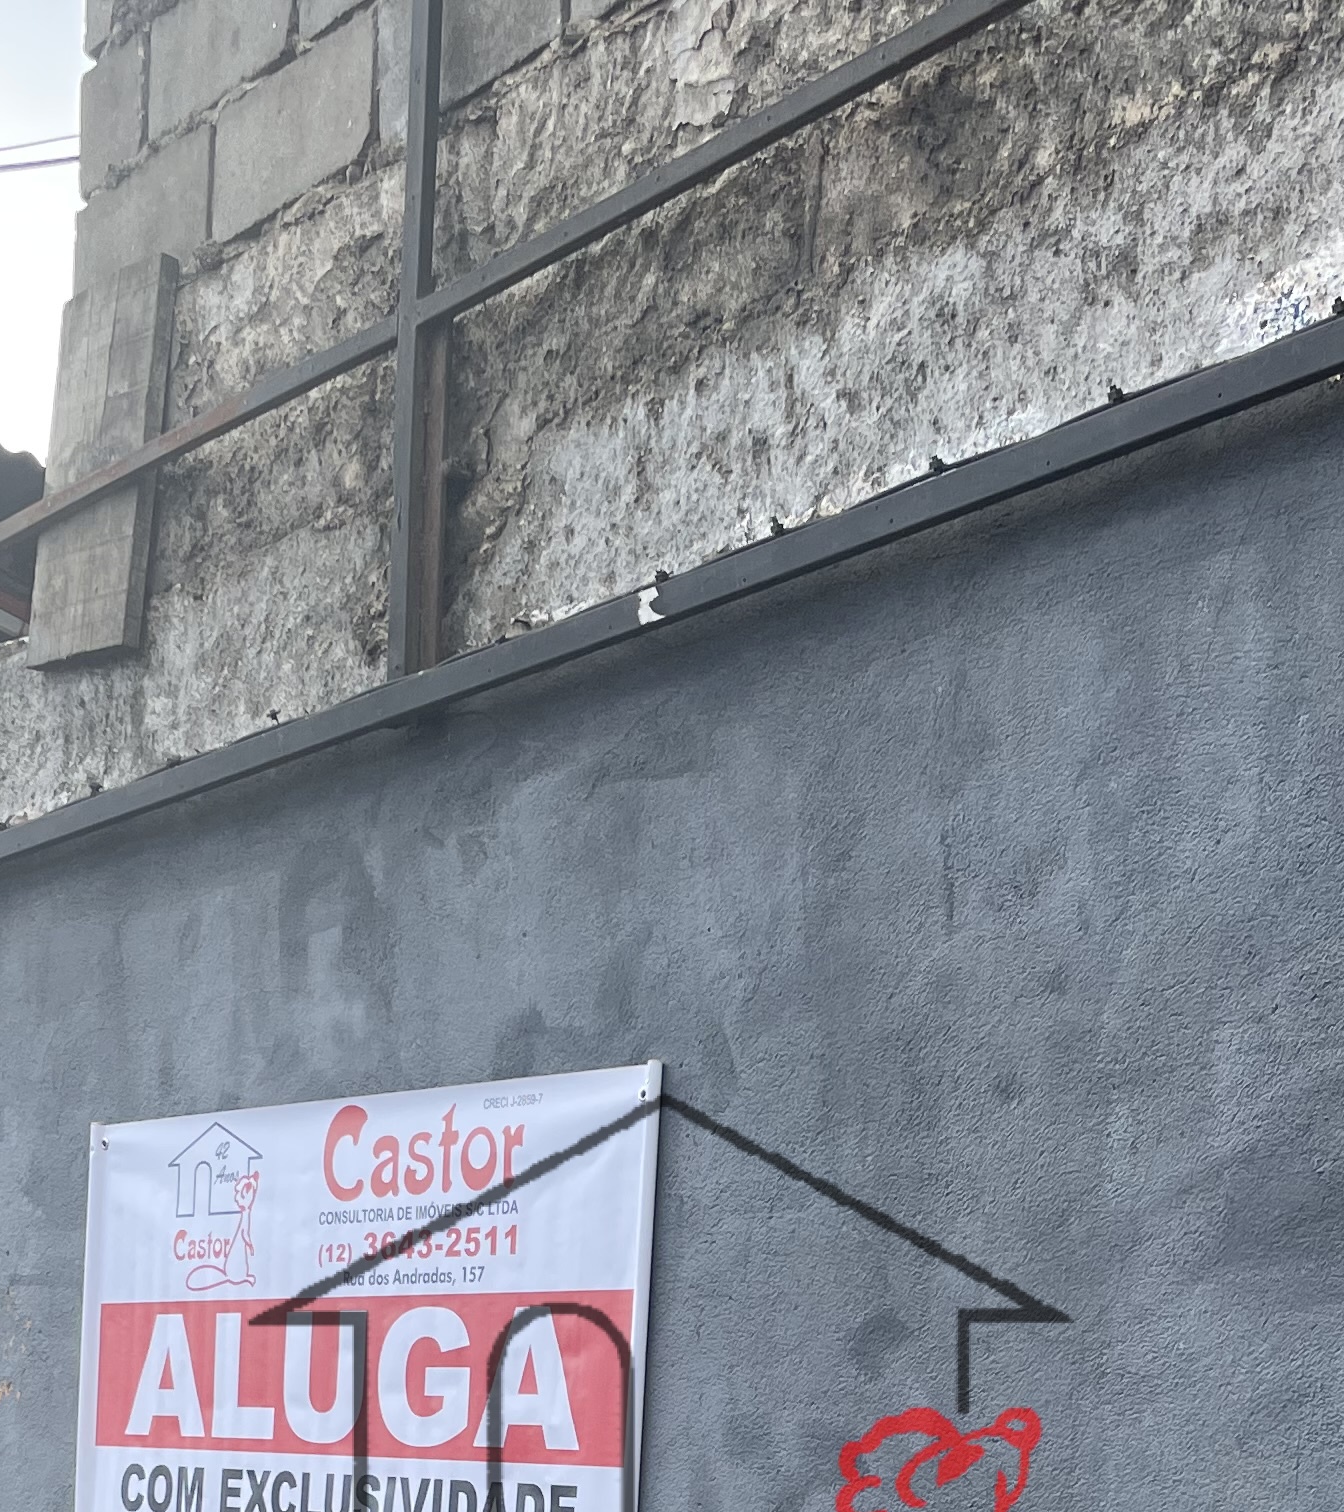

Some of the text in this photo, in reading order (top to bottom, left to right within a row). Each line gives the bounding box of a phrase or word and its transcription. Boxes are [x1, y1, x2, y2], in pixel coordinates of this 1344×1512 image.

[483, 1096, 509, 1110] CRECI
[323, 1102, 525, 1202] Castor
[318, 1207, 394, 1226] CONSULTORIA
[396, 1205, 413, 1222] DE
[414, 1200, 462, 1221] IMÓVEIS
[488, 1199, 519, 1216] LTDA
[173, 1229, 231, 1261] Castor
[318, 1223, 519, 1268] (12) 3643-2511
[343, 1265, 485, 1287] Rua dos Andradas, 157
[125, 1304, 581, 1452] ALUGA
